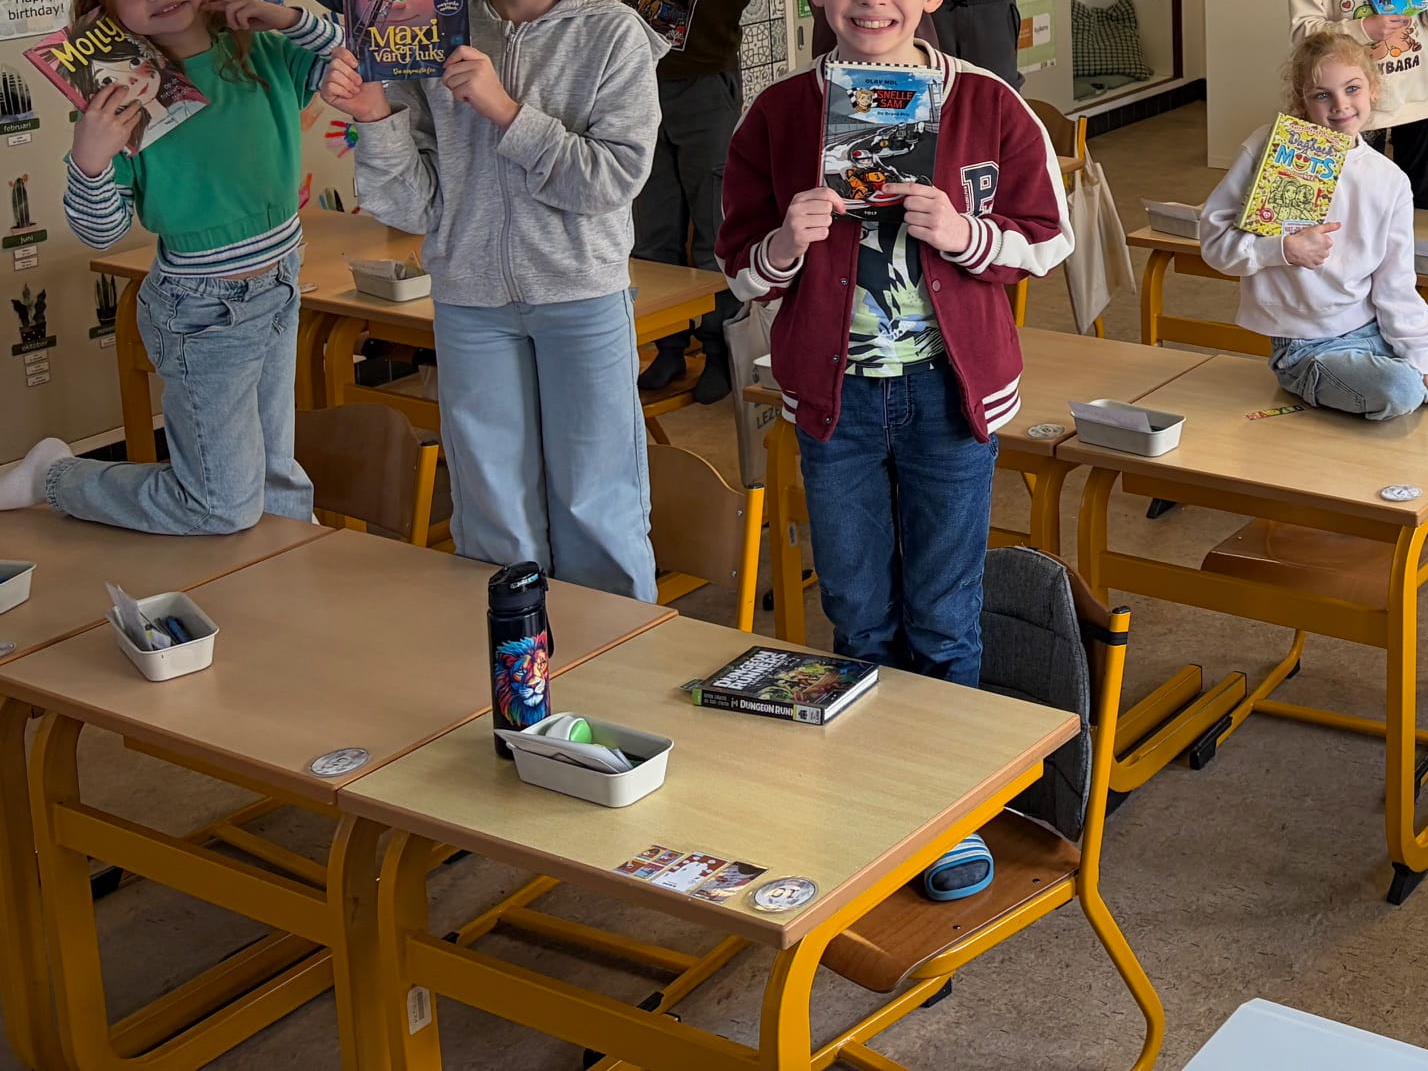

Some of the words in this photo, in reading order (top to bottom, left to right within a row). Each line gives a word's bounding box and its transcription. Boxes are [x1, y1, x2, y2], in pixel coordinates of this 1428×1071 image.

[8, 3, 65, 20] birthday!
[368, 18, 440, 53] Maxi
[396, 44, 446, 64] Fluks
[1378, 54, 1420, 75] YBARA
[877, 90, 914, 100] SNELLE
[880, 99, 903, 108] SAM
[4, 122, 32, 133] februari
[20, 235, 34, 244] juni
[713, 650, 774, 688] DUNGEON
[732, 652, 788, 690] RUNNERS
[739, 699, 775, 714] DUNGEON
